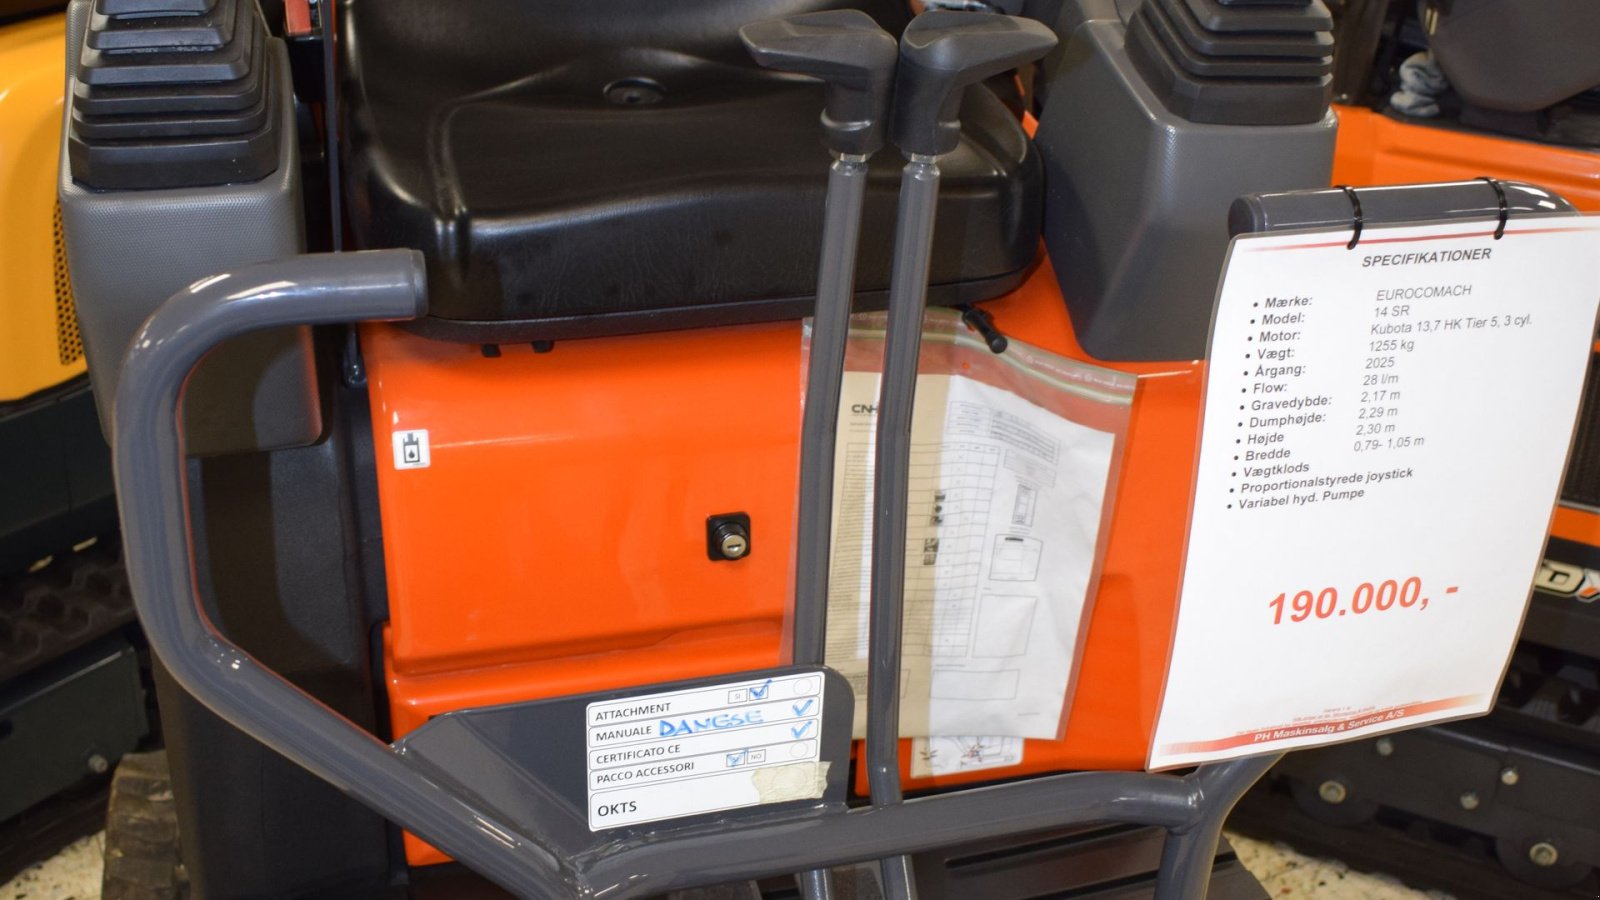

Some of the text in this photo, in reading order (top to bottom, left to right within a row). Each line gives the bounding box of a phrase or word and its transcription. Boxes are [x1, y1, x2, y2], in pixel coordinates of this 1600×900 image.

[1362, 248, 1491, 268] SPECIFIKATIONER
[1377, 285, 1472, 301] EUROCOMACH
[1265, 296, 1312, 308] Mærke:
[1262, 313, 1305, 325] Model:
[1374, 305, 1409, 318] 14 SR
[1371, 322, 1412, 335] Kubota
[1416, 320, 1441, 333] 13,7
[1444, 319, 1462, 329] HK
[1465, 317, 1487, 328] Tier
[1504, 315, 1512, 326] 3
[1514, 314, 1532, 328] cyl.
[1259, 330, 1301, 342] Motor:
[1369, 339, 1414, 353] 1255 kg
[1258, 348, 1295, 361] Vægt:
[1255, 363, 1306, 378] Årgang:
[1365, 357, 1395, 369] 2025
[1363, 374, 1379, 386] 28
[1253, 382, 1287, 394] Flow:
[1251, 396, 1332, 412] Gravedybde:
[1361, 391, 1400, 404] 2,17 m
[1249, 412, 1326, 429] Dumphøjde:
[1358, 407, 1398, 421] 2,29 m
[1356, 423, 1395, 437] 2,30 m
[1247, 432, 1284, 446] Højde
[1387, 438, 1411, 450] 1,05
[1413, 437, 1425, 446] m
[1245, 448, 1291, 461] Bredde
[1243, 462, 1309, 479] Vægtklods
[1241, 468, 1413, 495] Proportionalstyrede joystick
[1239, 488, 1364, 510] Variabel hyd. Pumpe
[1268, 575, 1430, 626] 190.000,
[595, 702, 671, 721] ATTACHMENT
[596, 725, 651, 741] MANUALE
[1254, 732, 1271, 742] PH
[1273, 726, 1335, 739] Maskinsalg
[1337, 722, 1345, 731] &
[1348, 715, 1384, 729] Service
[1385, 709, 1404, 720] A/S
[596, 744, 680, 764] CERTIFICATO CE
[597, 770, 633, 784] PACCO
[636, 762, 695, 778] ACCESSORI
[597, 801, 637, 817] OKTS
